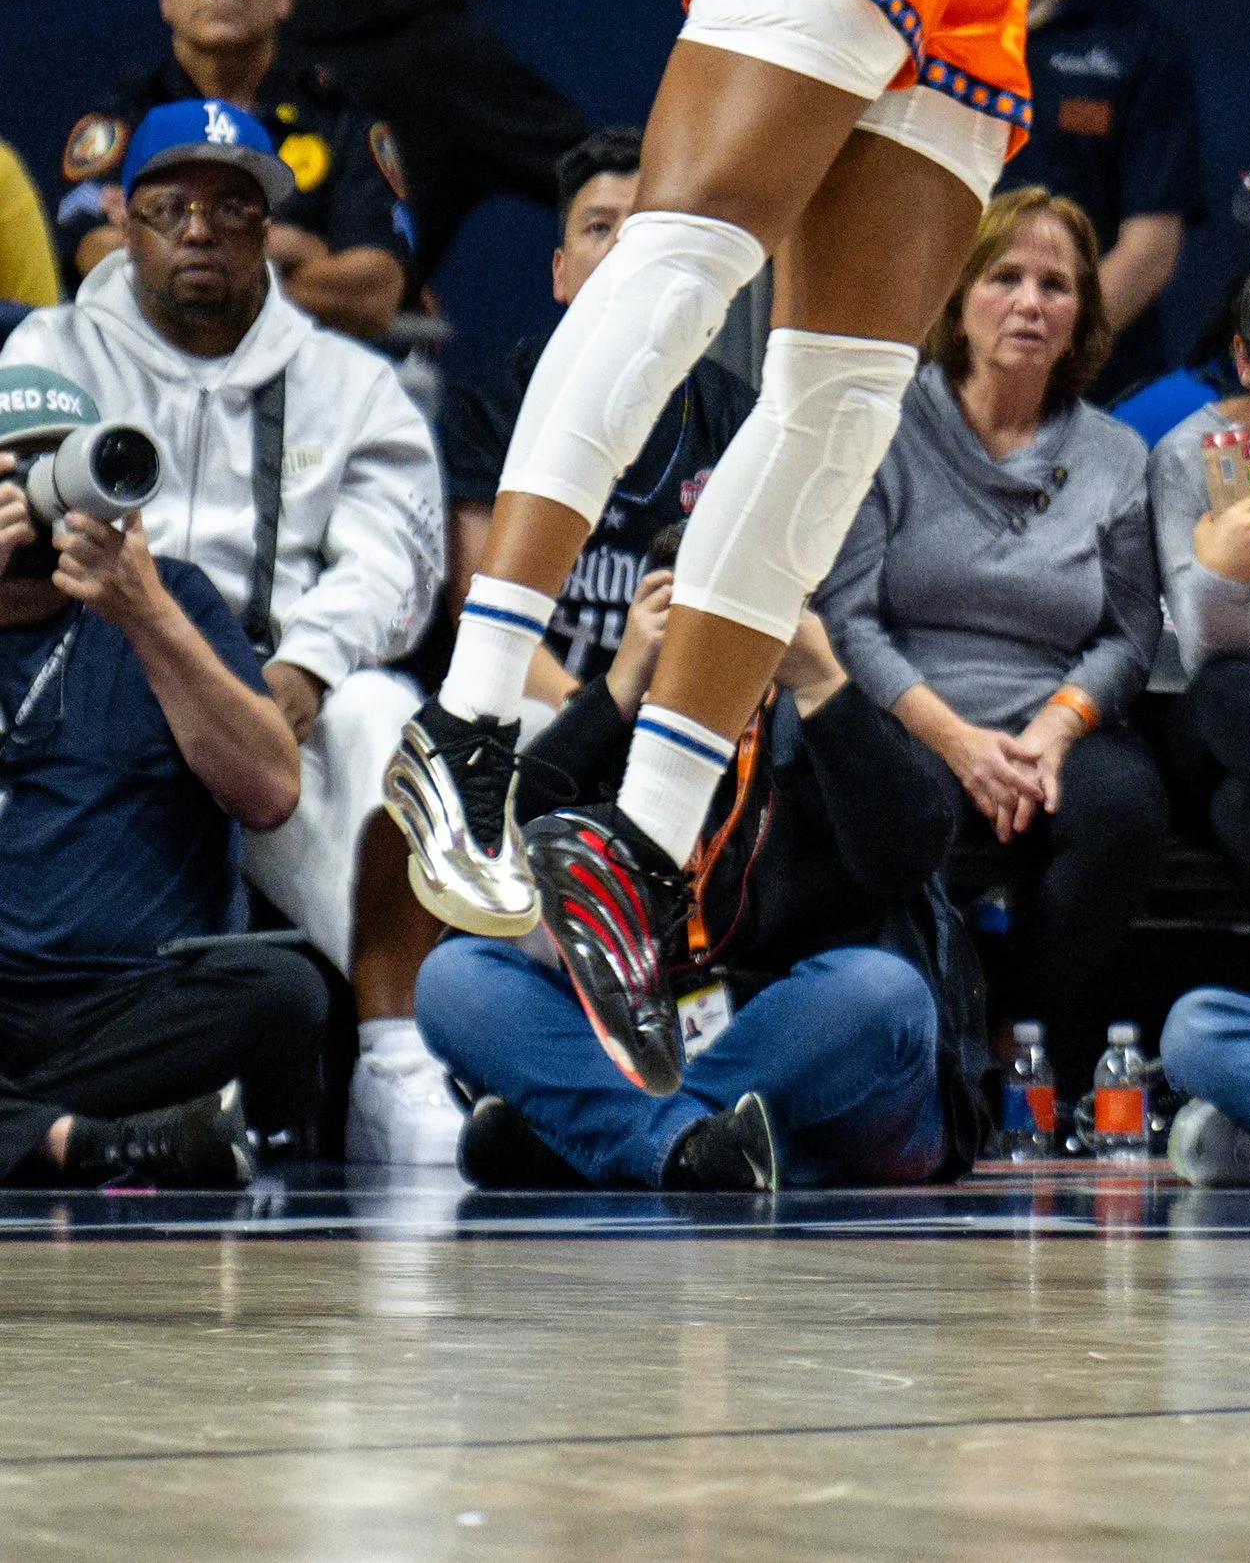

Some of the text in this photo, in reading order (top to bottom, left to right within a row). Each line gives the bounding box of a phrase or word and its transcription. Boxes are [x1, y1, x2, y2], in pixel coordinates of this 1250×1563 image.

[203, 102, 237, 144] LA
[0, 389, 82, 417] RED SOX
